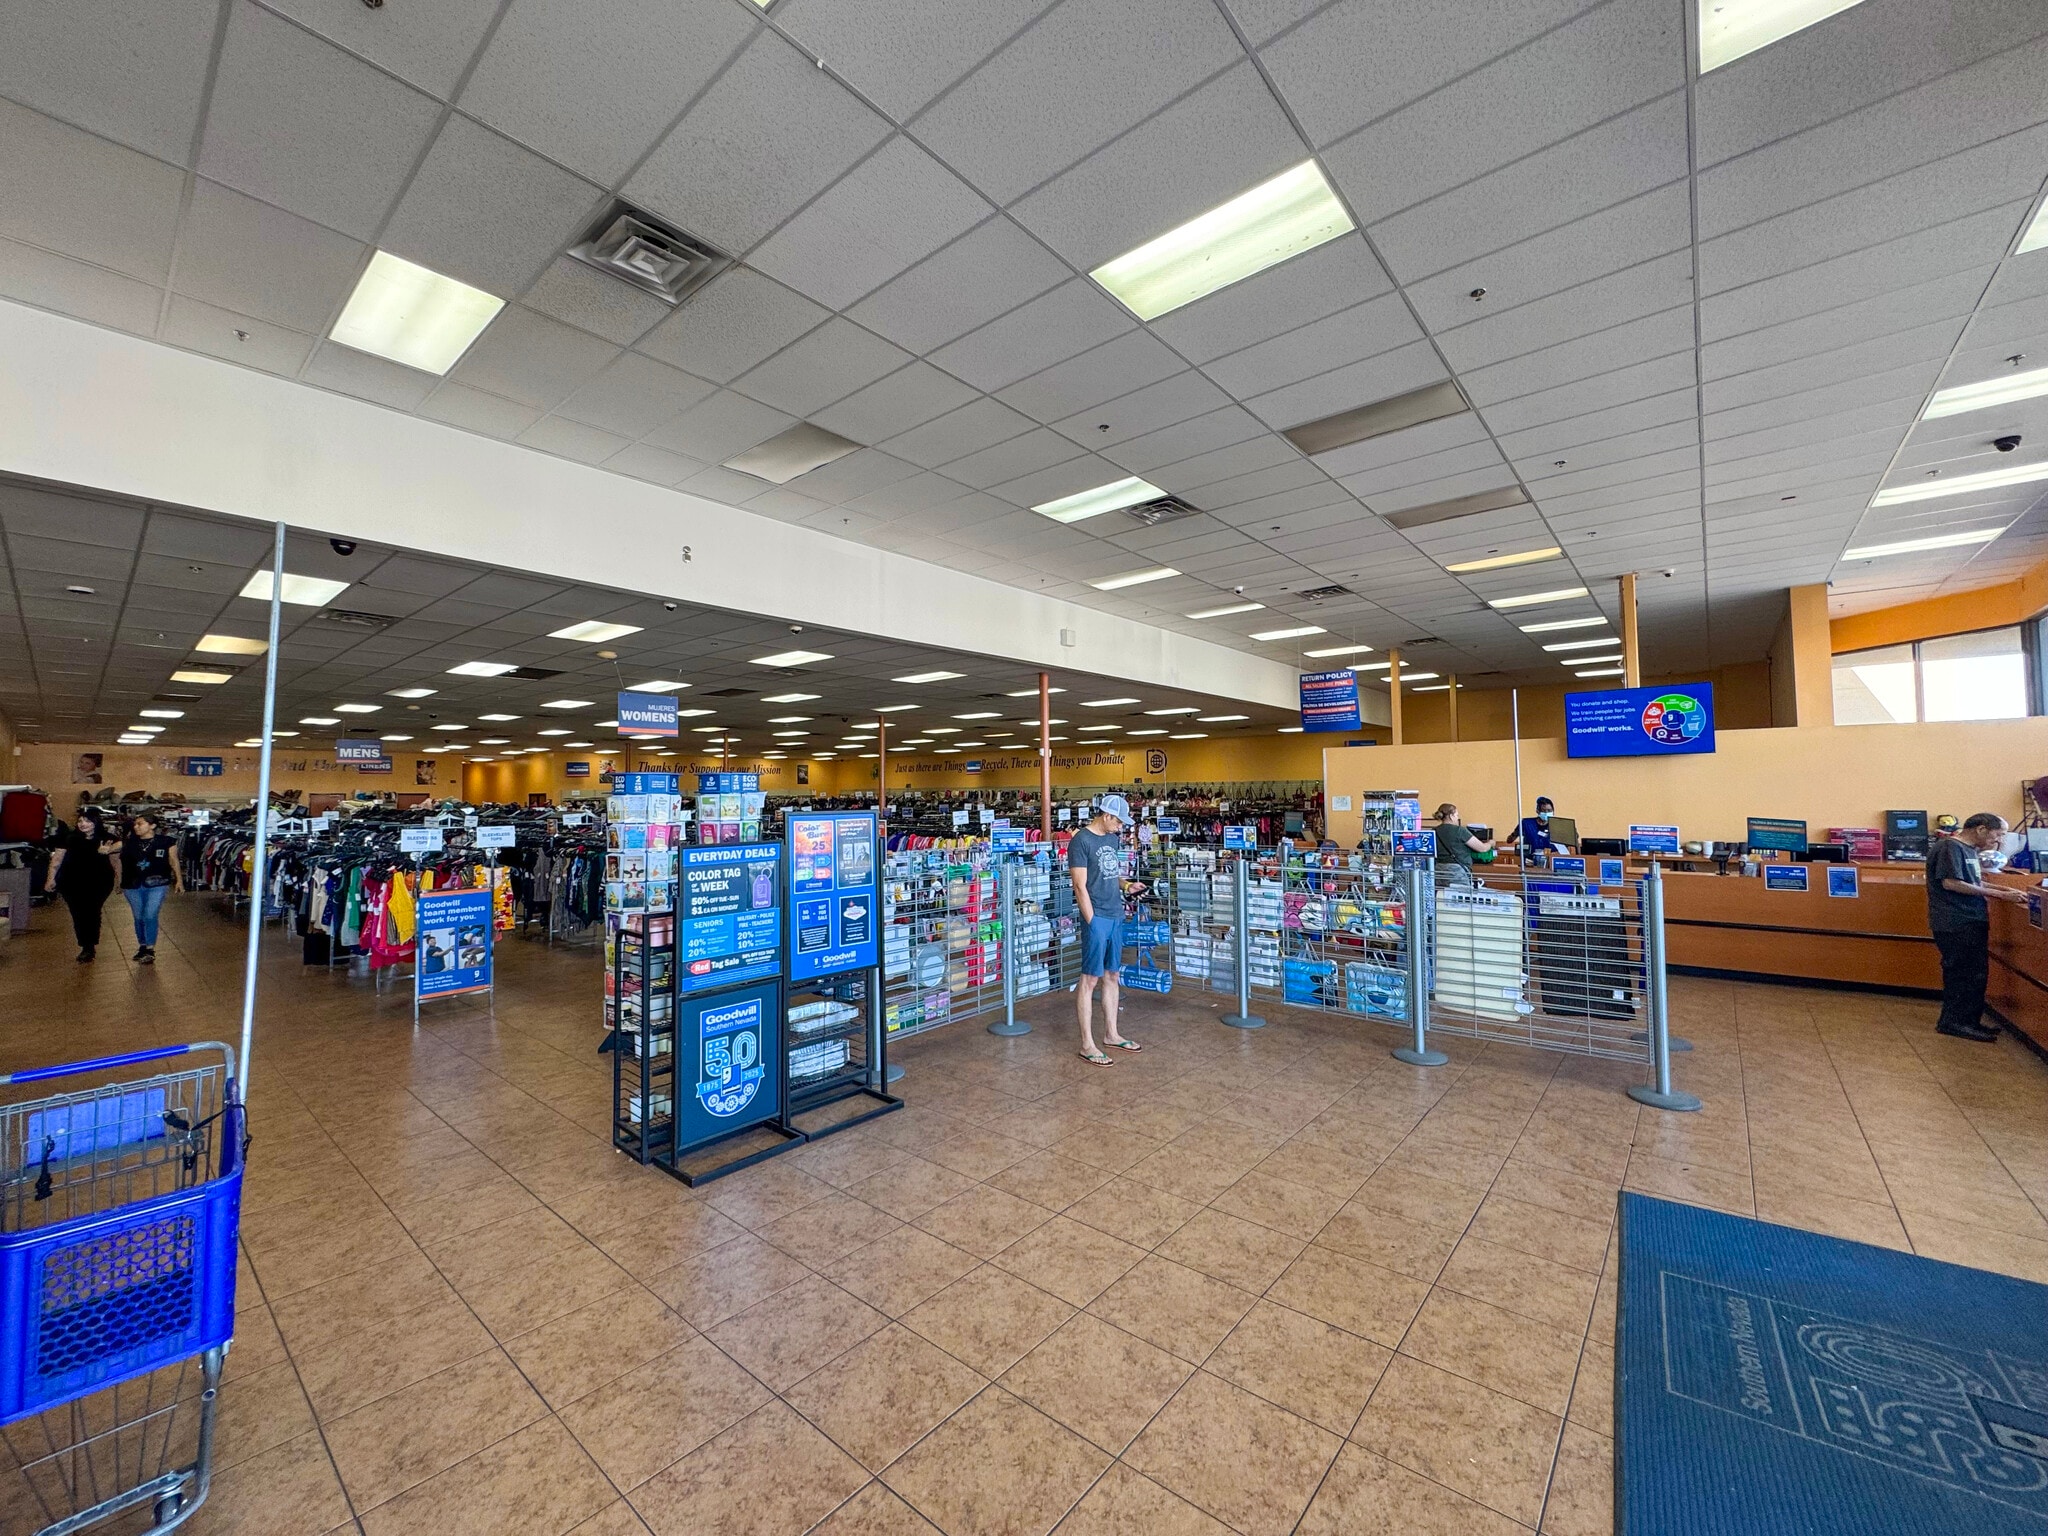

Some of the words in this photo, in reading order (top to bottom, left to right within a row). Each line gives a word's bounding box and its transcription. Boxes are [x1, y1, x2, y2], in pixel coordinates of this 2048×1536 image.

[1302, 674, 1324, 682] RETURN
[1326, 671, 1352, 680] POLICY
[648, 704, 676, 712] MUJERES
[621, 710, 676, 723] WOMENS
[340, 748, 380, 758] MENS
[638, 762, 671, 773] Thanks
[674, 762, 688, 774] for
[752, 764, 781, 774] Mission
[895, 763, 908, 773] Just
[916, 763, 931, 772] there
[932, 764, 942, 772] are
[944, 761, 966, 773] Things
[1011, 758, 1032, 769] There
[1076, 755, 1092, 769] you
[1094, 753, 1125, 765] Donate
[798, 824, 820, 832] Color
[812, 841, 826, 850] 25
[690, 850, 743, 862] EVERYDAY
[745, 848, 776, 859] DEALS
[688, 870, 721, 881] COLOR
[723, 868, 741, 878] TAG
[701, 880, 729, 892] WEEK
[424, 899, 460, 909] Goodwill
[691, 896, 710, 905] 50%
[424, 909, 446, 917] team
[448, 905, 486, 915] members
[691, 906, 703, 915] $1
[460, 914, 476, 922] you.
[693, 919, 724, 929] SENIORS
[737, 931, 754, 940] 20%
[688, 938, 706, 948] 40%
[738, 940, 754, 949] 10%
[688, 948, 706, 958] 20%
[822, 950, 856, 962] Goodwill
[695, 962, 709, 972] Red
[711, 960, 724, 969] Tag
[724, 958, 740, 966] Sale
[706, 1005, 757, 1025] Goodwill
[706, 1019, 734, 1033] Southern
[735, 1016, 757, 1026] Nevada
[706, 1031, 756, 1077] 50
[744, 1070, 759, 1079] 2025
[703, 1081, 719, 1091] 1975
[1728, 1296, 1757, 1344] Nevada
[1738, 1344, 1772, 1414] Southern
